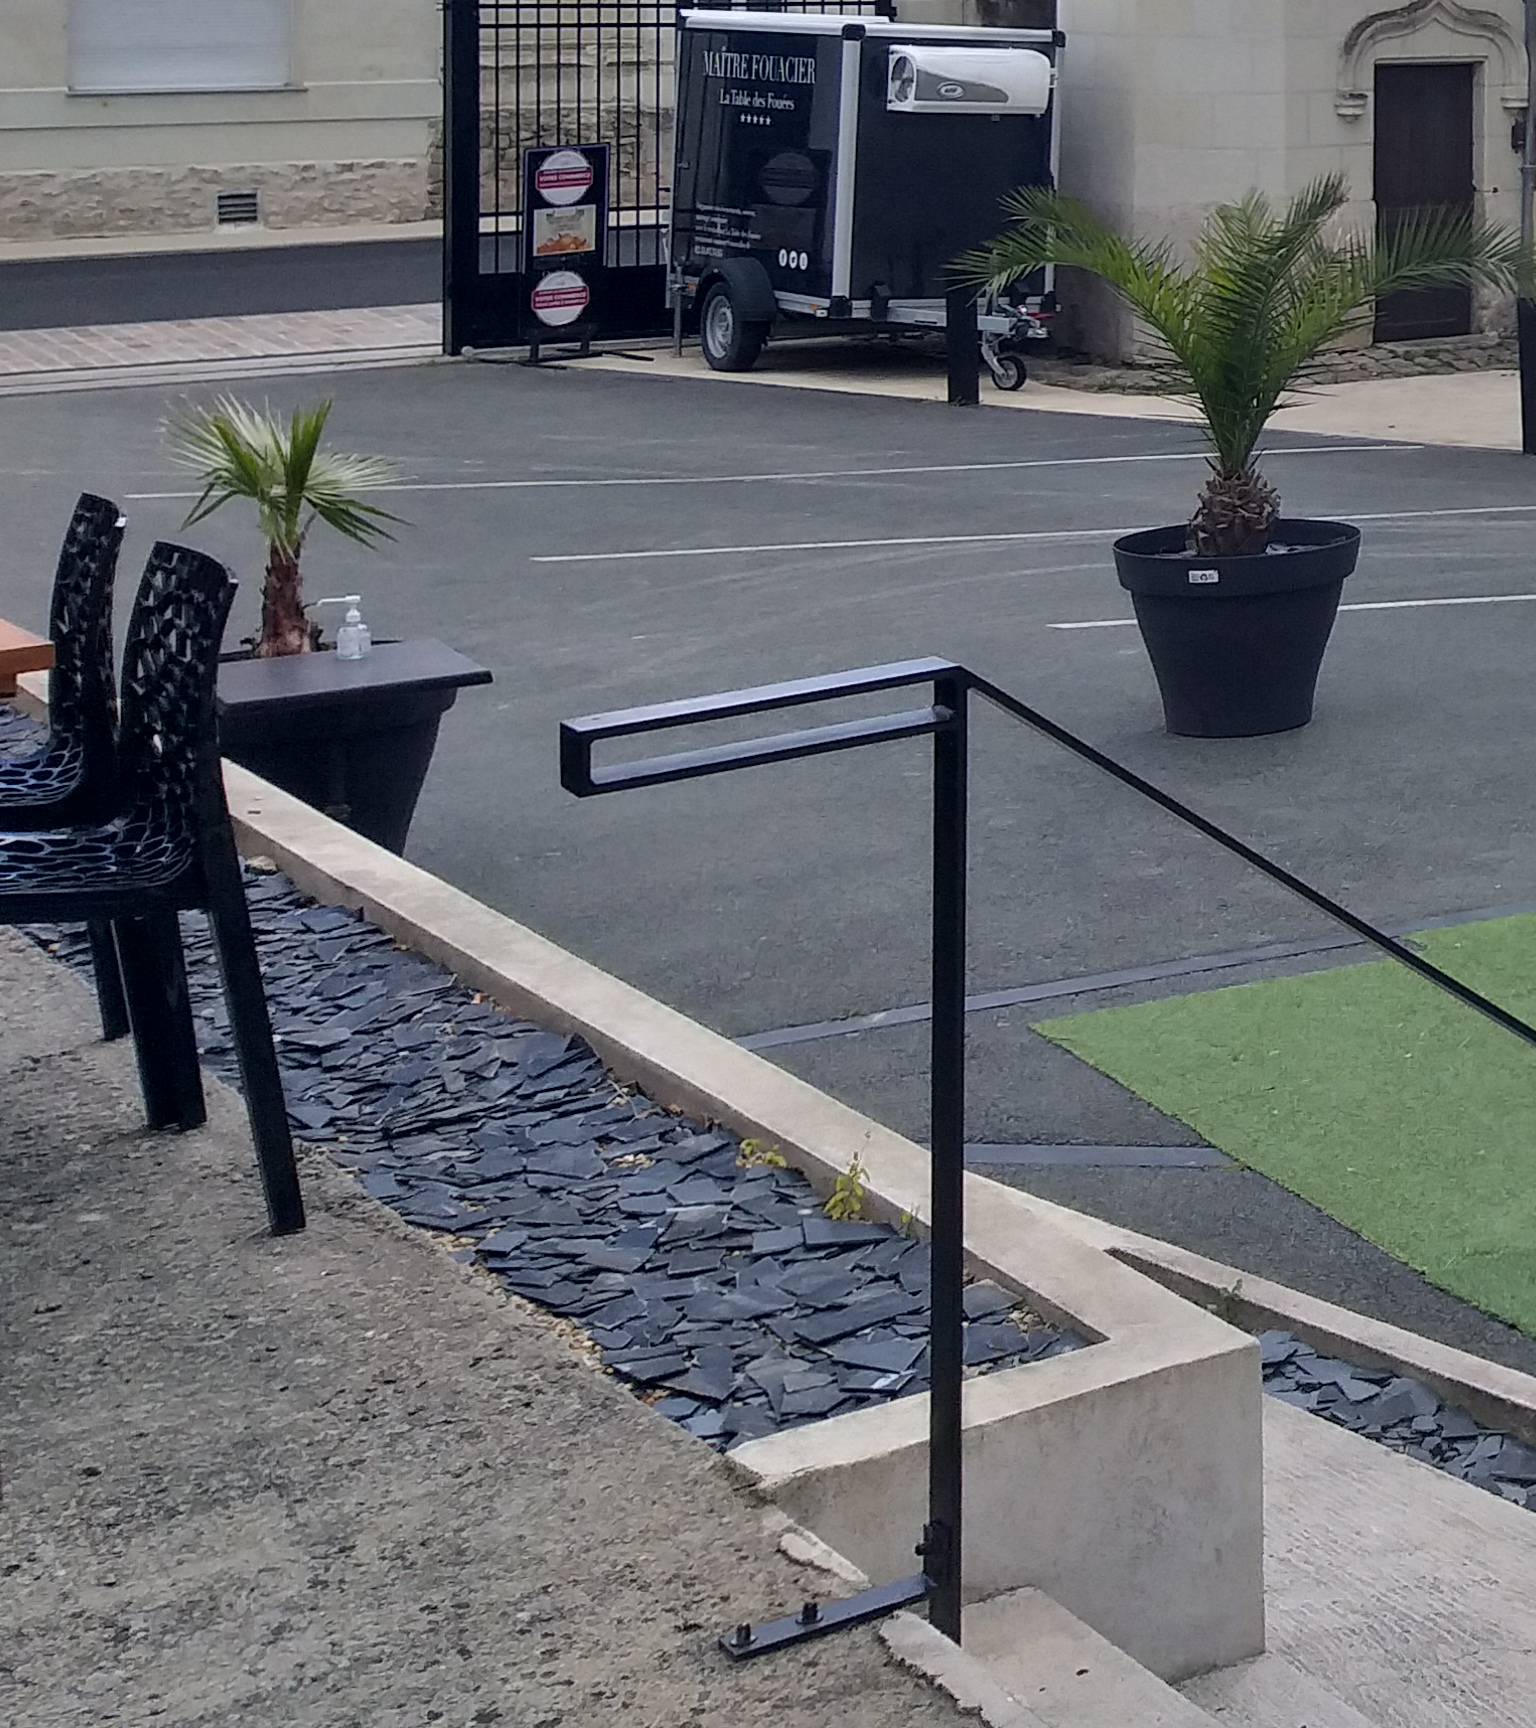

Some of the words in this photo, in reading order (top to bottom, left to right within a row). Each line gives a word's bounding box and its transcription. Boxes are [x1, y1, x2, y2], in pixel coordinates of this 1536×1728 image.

[703, 46, 749, 79] MAÎTRE
[751, 54, 816, 84] FOUACIER
[720, 88, 730, 105] La
[731, 89, 751, 107] Table
[752, 91, 766, 108] des
